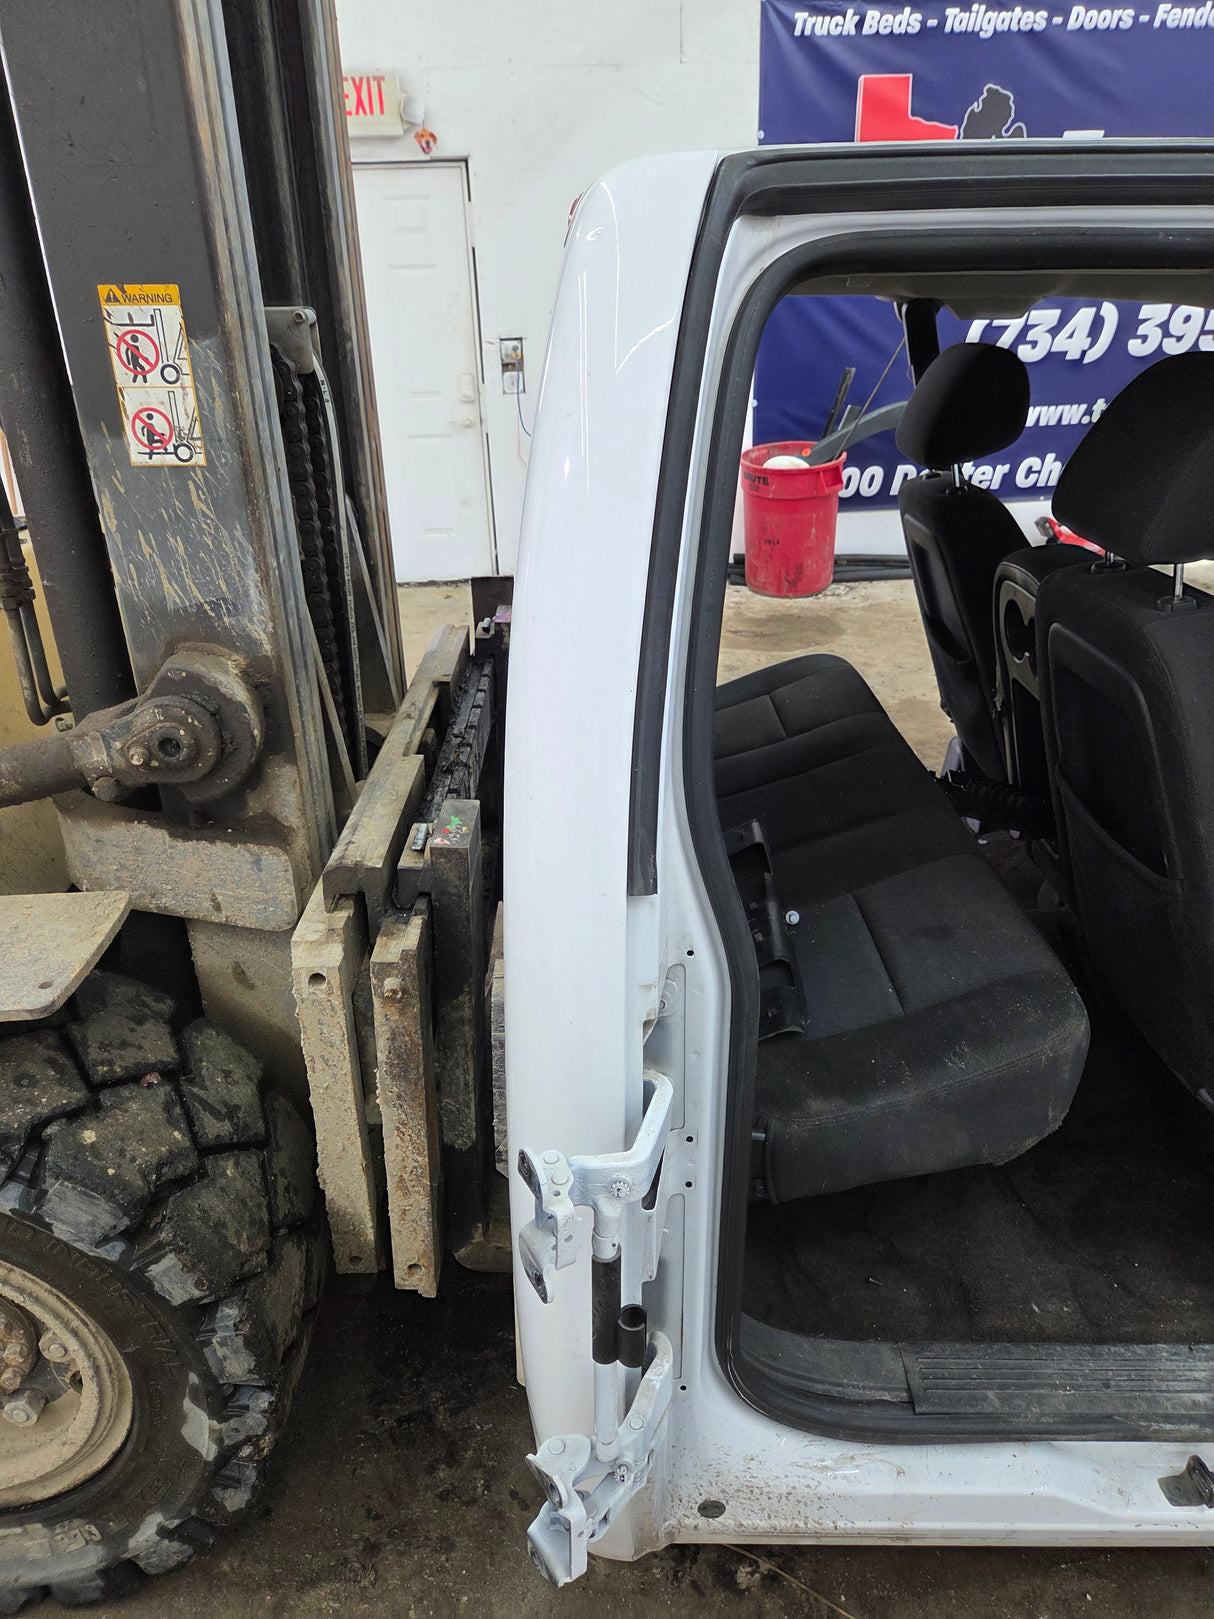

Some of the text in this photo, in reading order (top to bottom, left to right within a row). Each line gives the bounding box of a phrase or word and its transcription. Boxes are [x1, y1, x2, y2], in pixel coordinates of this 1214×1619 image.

[794, 8, 861, 37] Truck
[861, 6, 923, 35] Beds
[944, 3, 1048, 39] Tailgates
[1066, 5, 1135, 32] Doors
[121, 292, 173, 304] WARNING
